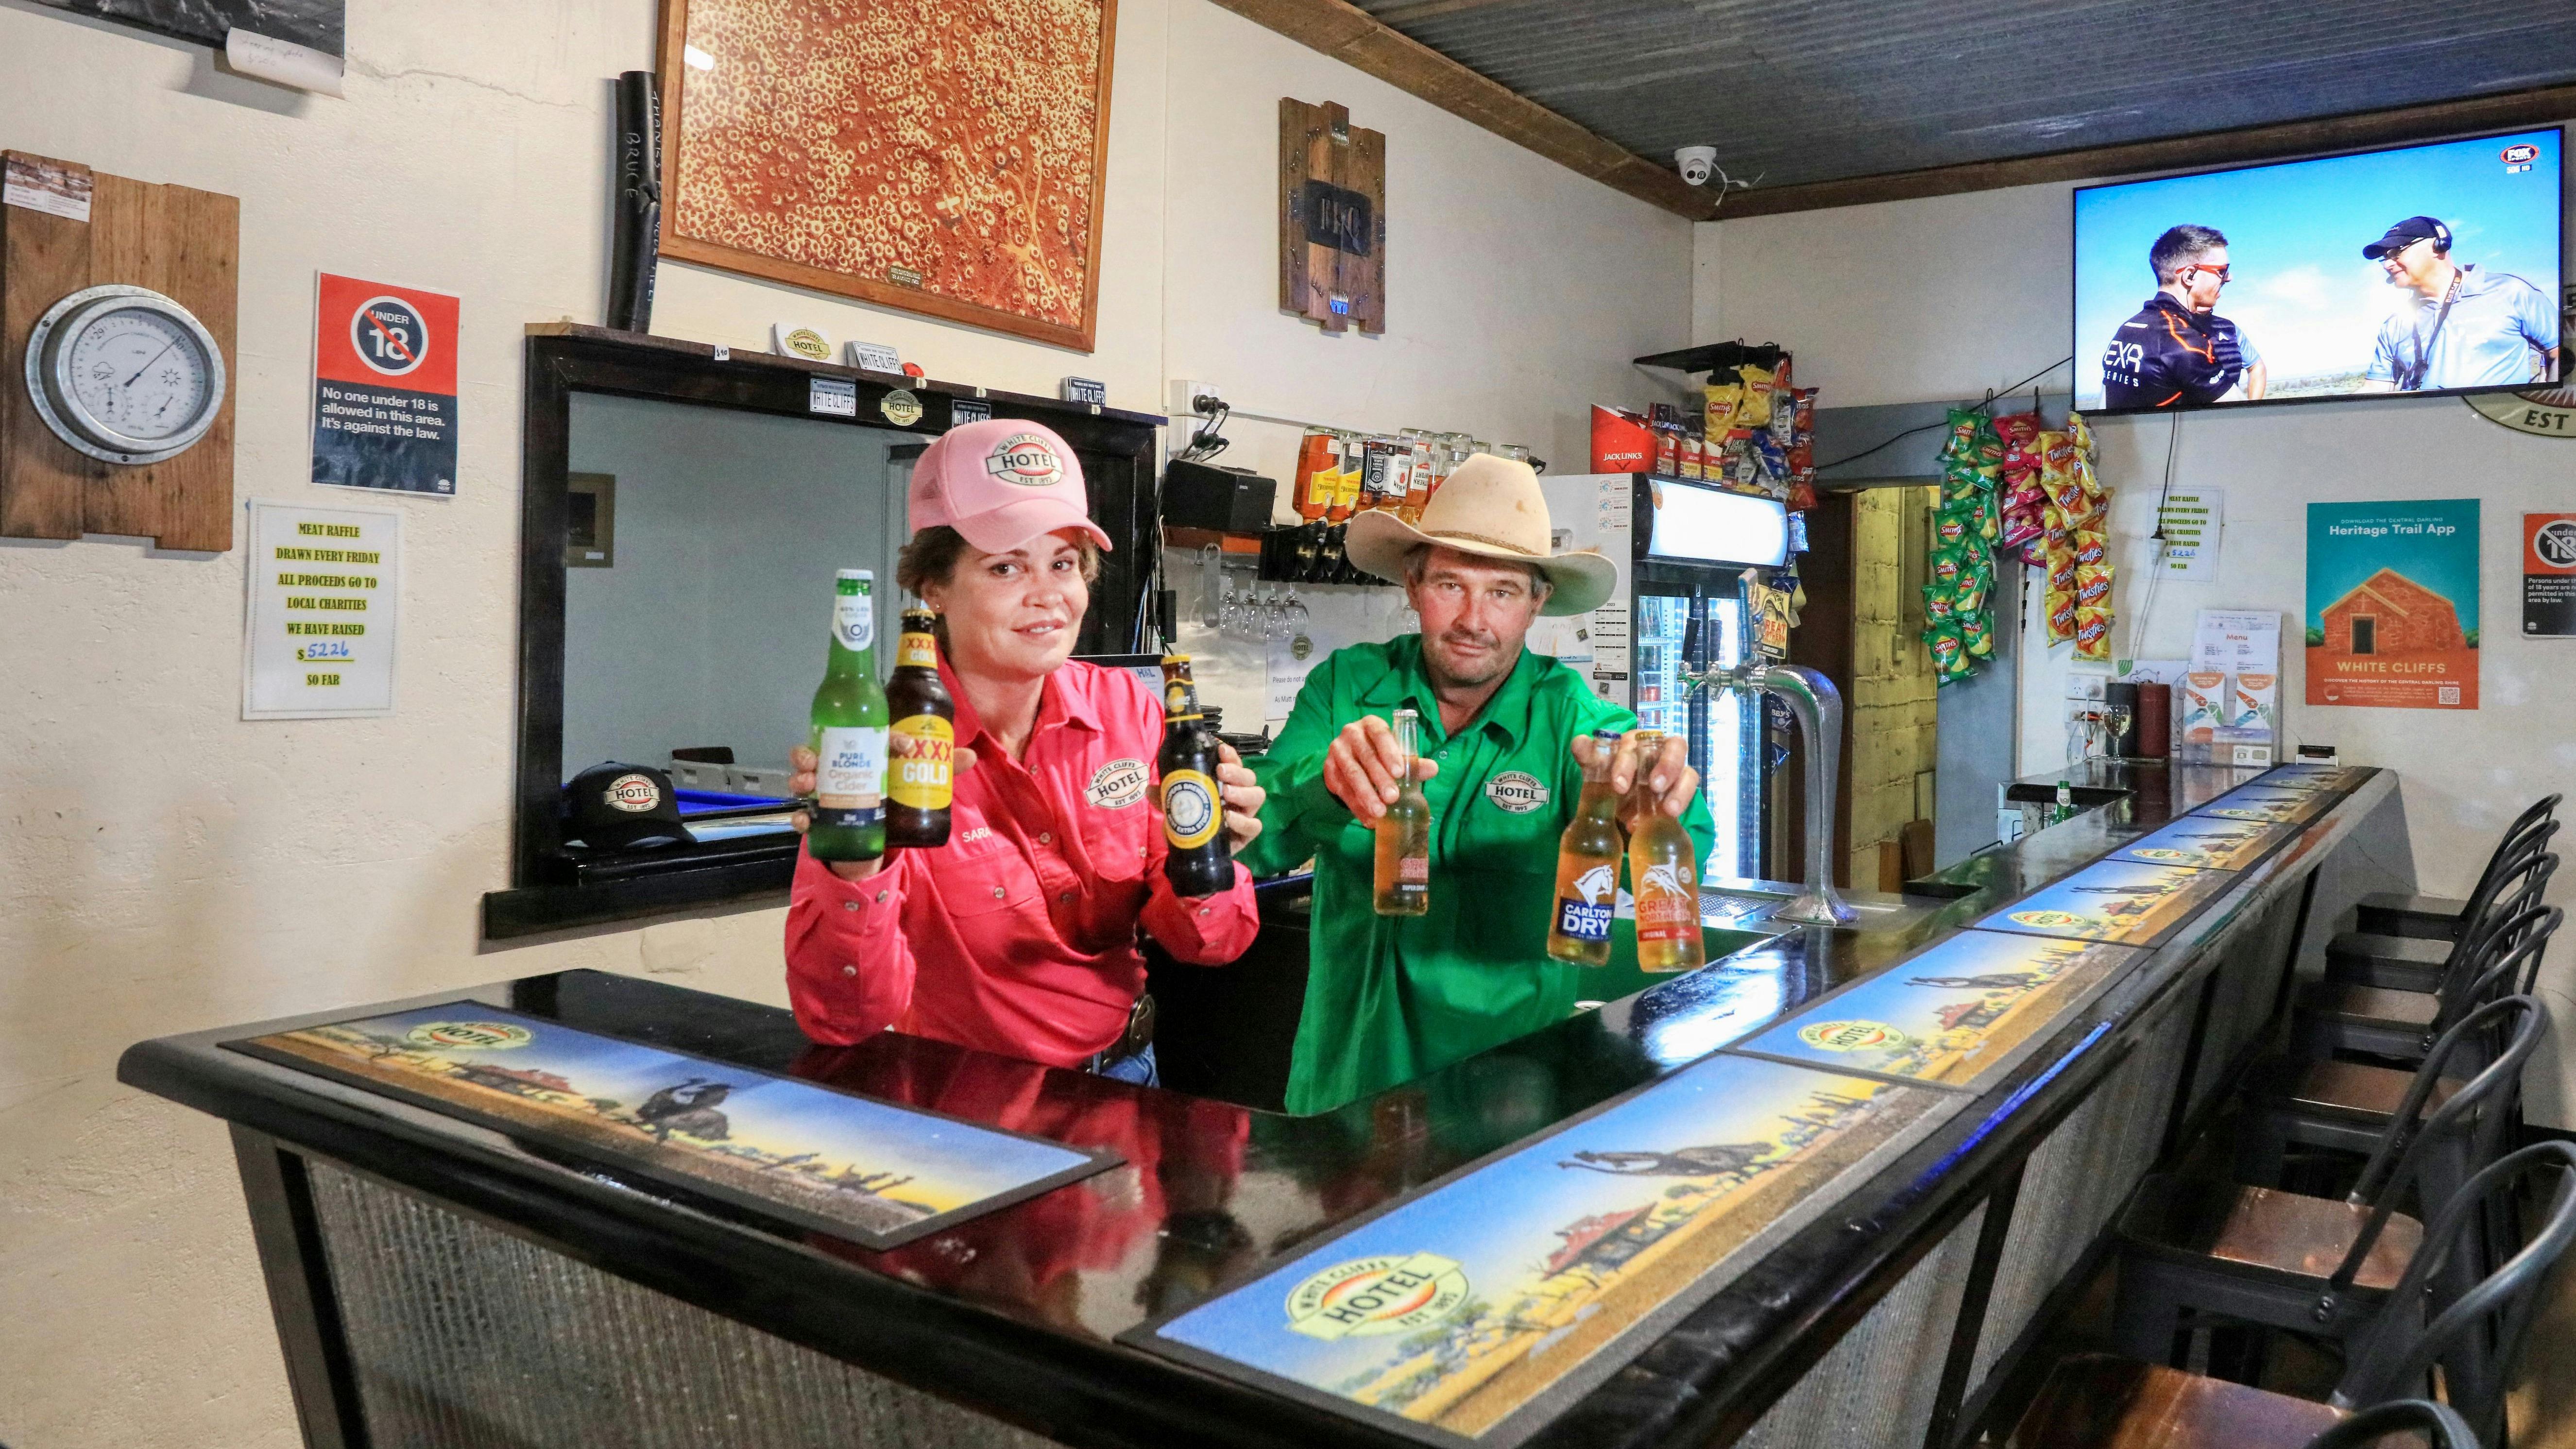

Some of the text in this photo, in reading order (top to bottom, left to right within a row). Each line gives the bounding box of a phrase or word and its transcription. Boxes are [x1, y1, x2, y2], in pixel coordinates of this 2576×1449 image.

[2508, 147, 2531, 159] FOX
[625, 133, 641, 198] BRUCE
[2507, 165, 2520, 174] 506
[371, 310, 409, 324] UNDER
[369, 327, 409, 360] 18
[793, 331, 821, 343] WHITE CLIFFS
[793, 341, 822, 352] HOTEL
[859, 353, 901, 371] WHITE CLIFFS
[323, 387, 438, 411] No one under 18 is
[813, 390, 854, 409] WHITE CLIFFS
[1072, 387, 1105, 404] WHITE CLIFFS
[322, 404, 445, 426] allowed in this area.
[889, 402, 915, 413] HOTEL
[954, 409, 971, 425] WHITE
[2524, 409, 2569, 430] EST
[322, 416, 440, 440] It's against the law.
[1000, 435, 1051, 451] WHITE CLIFFS
[1002, 453, 1056, 468] HOTEL
[1604, 453, 1621, 461] JACK
[2048, 444, 2074, 461] Twisties
[299, 523, 360, 537] MEAT RAFFLE
[2330, 523, 2456, 537] Heritage Trail App
[276, 547, 380, 563] DRAWN EVERY FRIDAY
[2079, 547, 2102, 562] Twisties
[2547, 536, 2576, 559] 18
[278, 574, 376, 588] ALL PROCEEDS GO TO
[2079, 581, 2109, 601] Twisties
[287, 597, 366, 610] LOCAL CHARITIES
[287, 623, 365, 635] WE HAVE RAISED
[2078, 623, 2105, 641] Twisties
[308, 640, 349, 658] 5226
[1935, 640, 1956, 651] SMITH'S
[2337, 661, 2446, 674] WHITE CLIFFS
[307, 674, 340, 685] SO FAR
[839, 752, 865, 760] PURE
[828, 769, 873, 781] Organic
[903, 762, 948, 785] GOLD
[1095, 761, 1136, 784] WHITE CLIFFS
[1498, 774, 1536, 787] WHITE CLIFFS
[615, 776, 651, 787] WHITE CLIFFS
[835, 781, 867, 791] Cider
[1097, 772, 1143, 798] HOTEL
[616, 788, 653, 800] HOTEL
[1496, 785, 1536, 800] HOTEL
[1115, 798, 1126, 806] EST
[962, 826, 993, 843] SARA
[1565, 903, 1612, 919] CARLTON
[1562, 913, 1611, 936] DRY
[432, 1026, 505, 1044] HOTEL
[1827, 1026, 1877, 1046] HOTEL
[1330, 1260, 1389, 1280] CLIFFS
[1323, 1269, 1433, 1324] HOTEL
